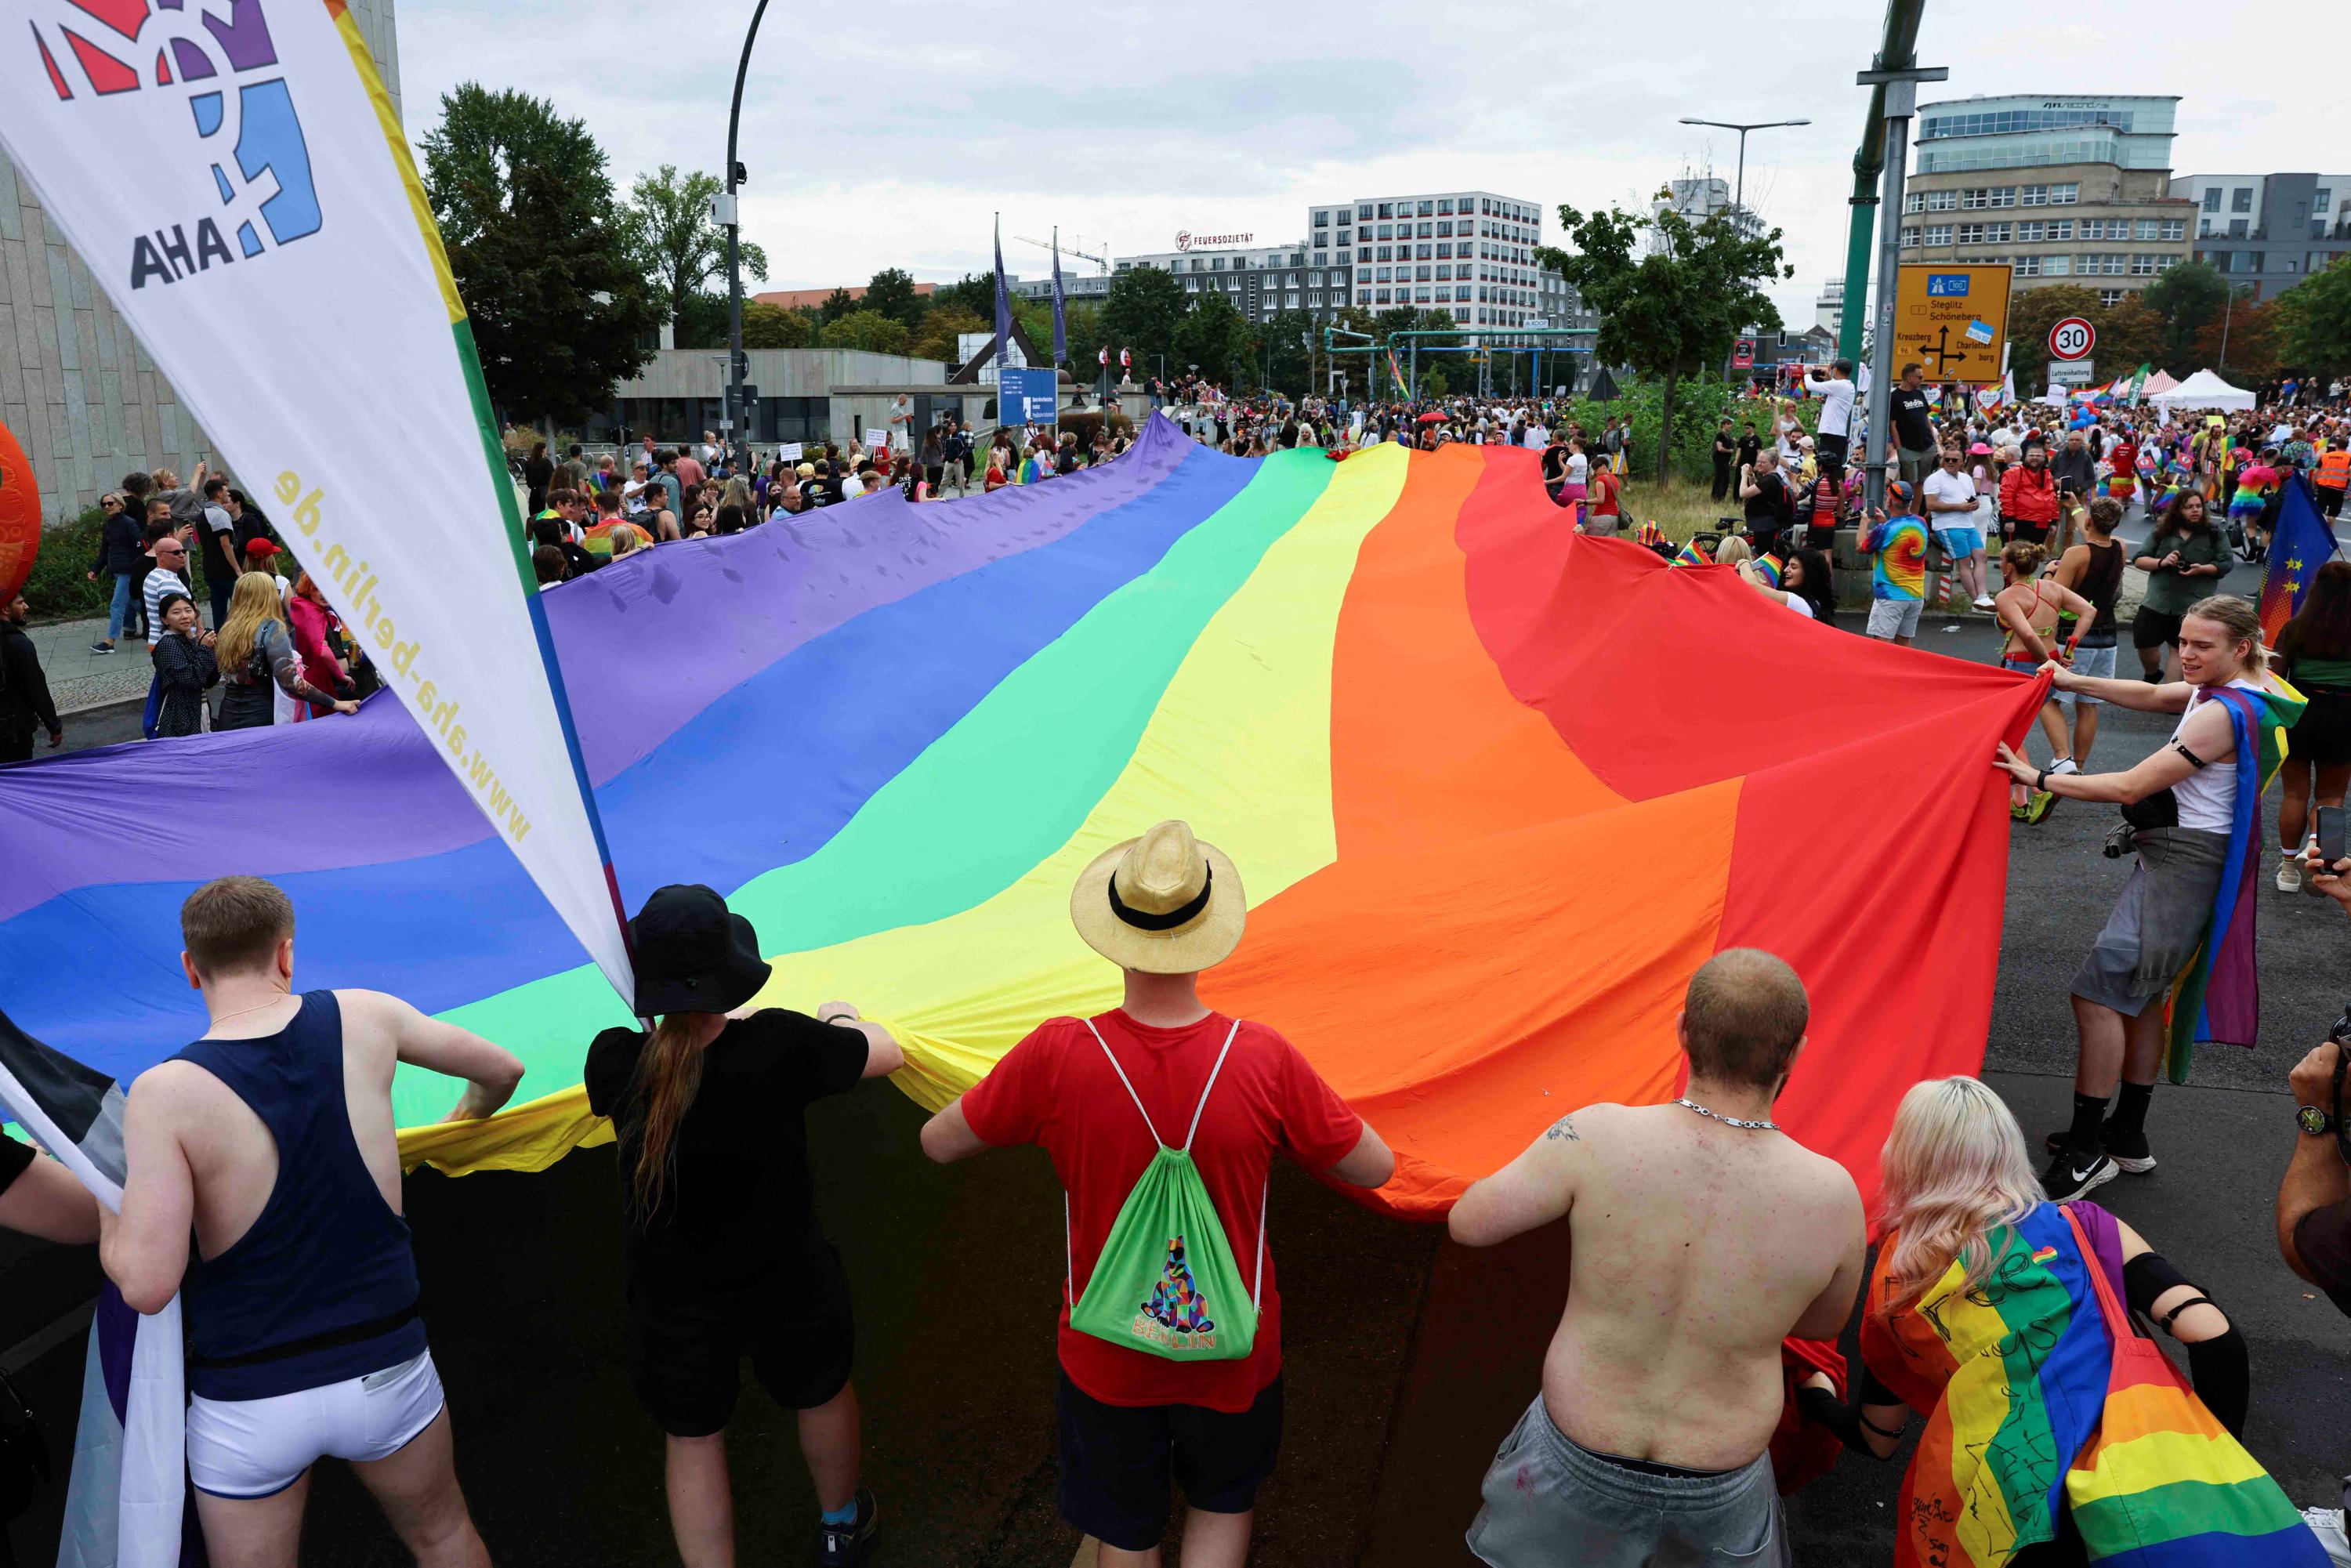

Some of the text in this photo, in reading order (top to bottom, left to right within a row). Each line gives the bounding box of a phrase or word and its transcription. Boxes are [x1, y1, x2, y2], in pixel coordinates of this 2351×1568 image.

[1194, 233, 1254, 245] FEUERSOZIETÄT
[131, 217, 234, 290] AHA
[1930, 300, 1962, 310] Steglitz
[1929, 312, 1981, 321] Schöneberg
[1897, 332, 1932, 343] Kreuzberg
[2059, 329, 2085, 349] 30
[1956, 341, 1996, 349] Charlotten-
[1979, 353, 1994, 363] burg
